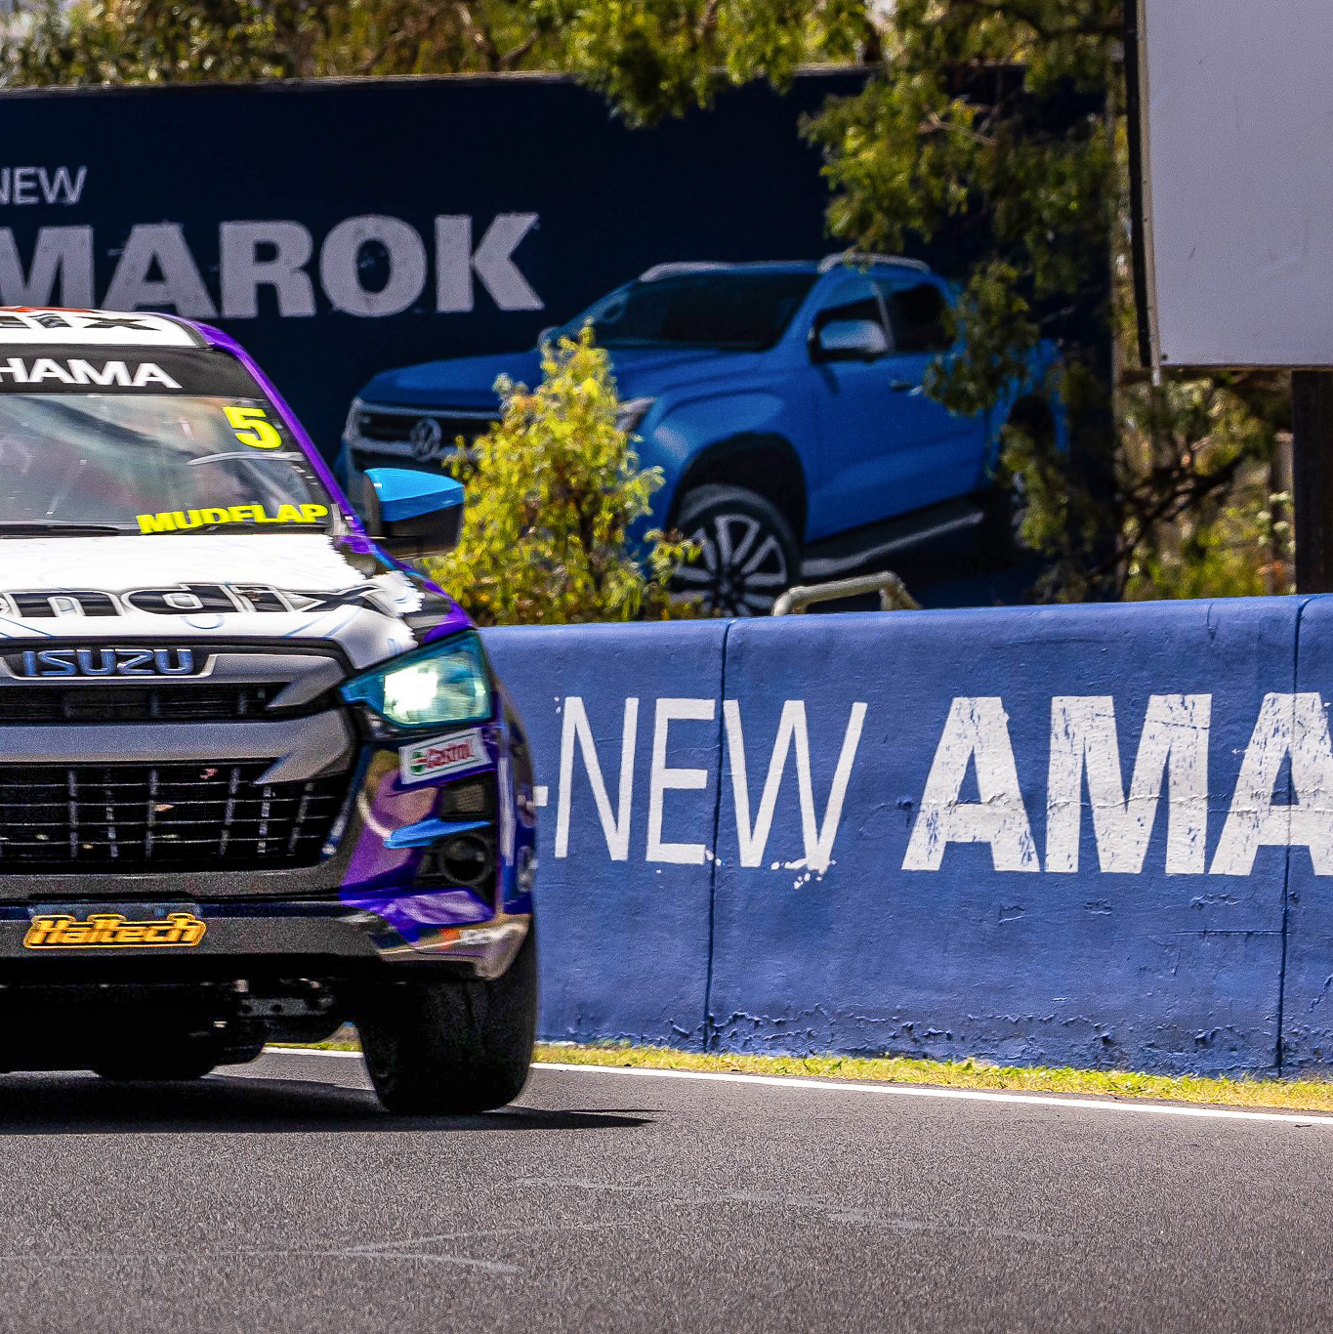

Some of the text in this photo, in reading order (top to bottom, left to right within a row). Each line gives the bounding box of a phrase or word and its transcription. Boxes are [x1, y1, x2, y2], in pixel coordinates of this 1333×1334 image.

[222, 406, 283, 449] 5
[136, 504, 329, 534] MUDFLAP
[23, 649, 193, 677] ISUZU
[901, 692, 1333, 876] AMA
[25, 914, 205, 948] Haltech
